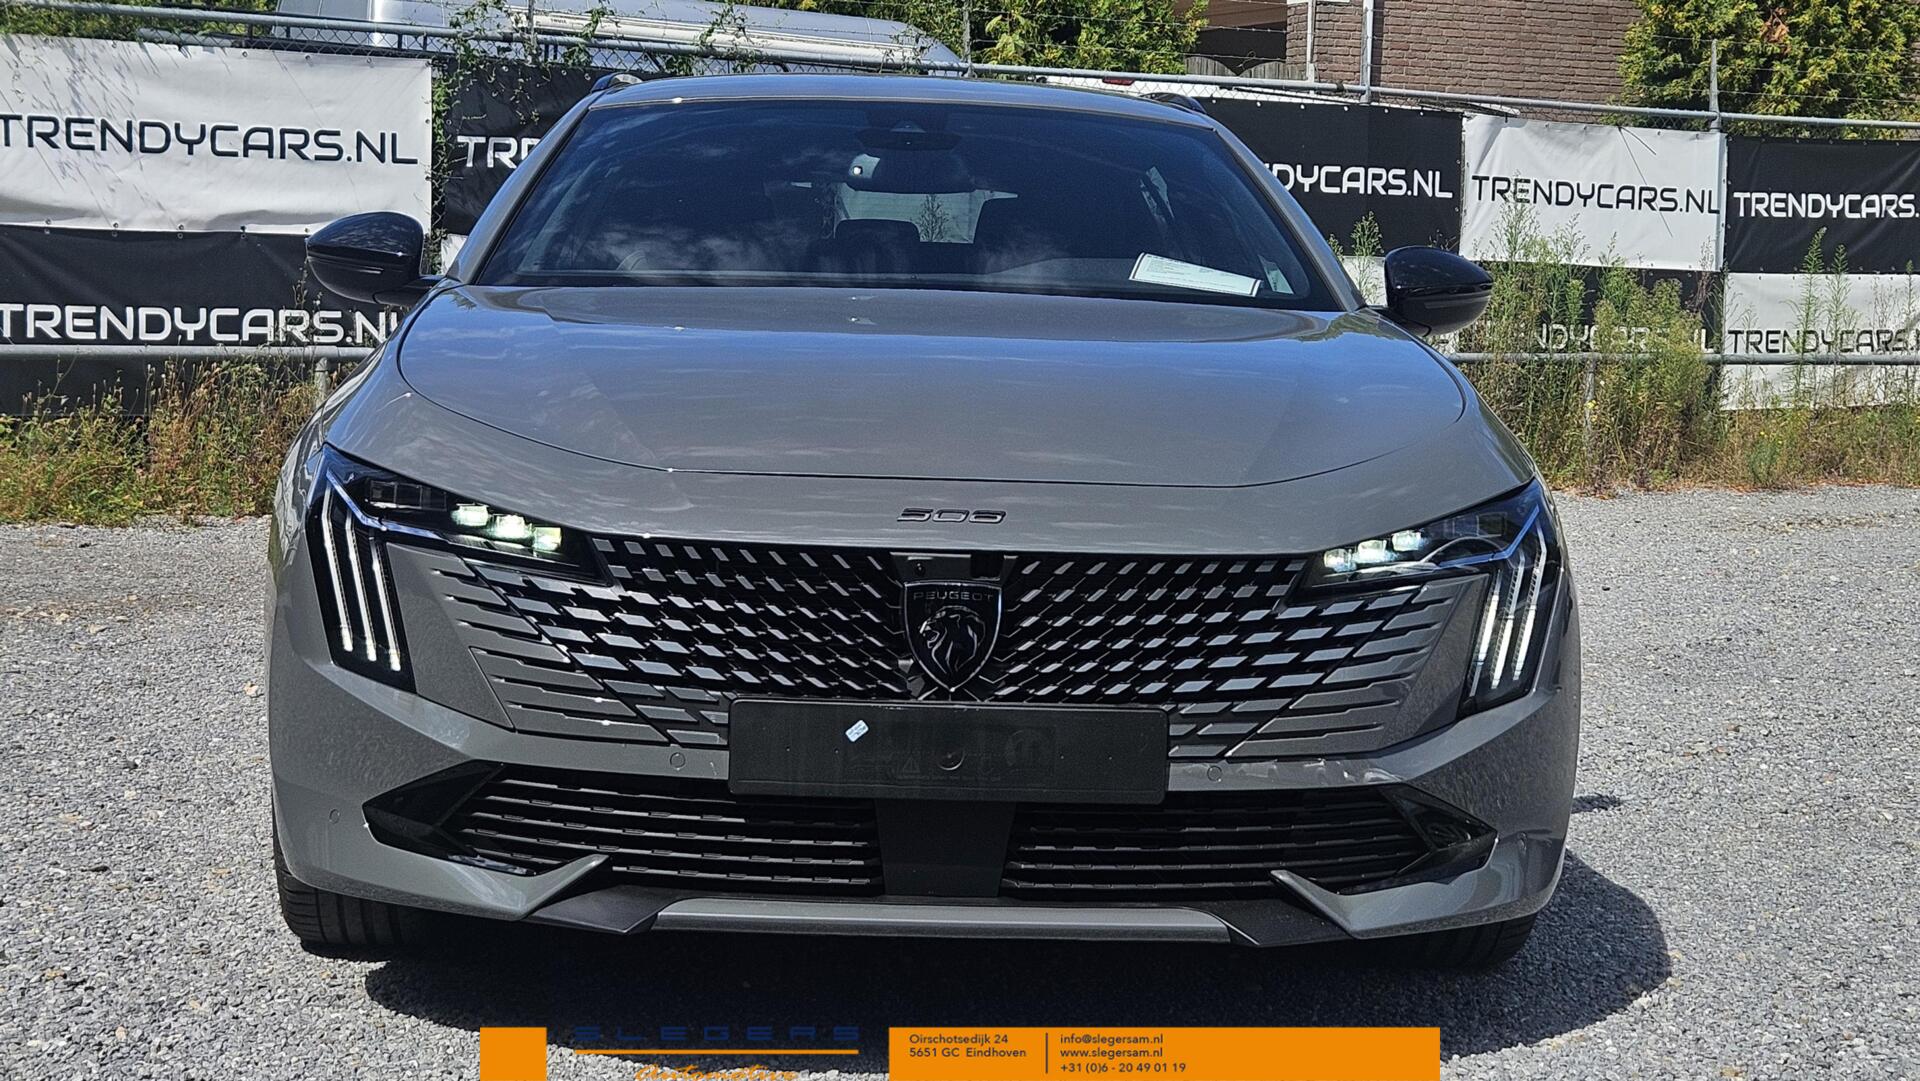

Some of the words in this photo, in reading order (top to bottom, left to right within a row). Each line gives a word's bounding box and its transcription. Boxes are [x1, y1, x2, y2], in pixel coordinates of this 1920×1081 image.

[0, 113, 418, 164] TRENDYCARS.NL
[1264, 163, 1453, 198] DYCARS.NL
[1472, 175, 1720, 214] TRENDYCARS.NL
[1733, 192, 1919, 218] TRENDYCARS.
[1728, 329, 1920, 354] TRENDYCARS.
[897, 508, 1006, 524] 508
[913, 591, 994, 601] PEUGEOT
